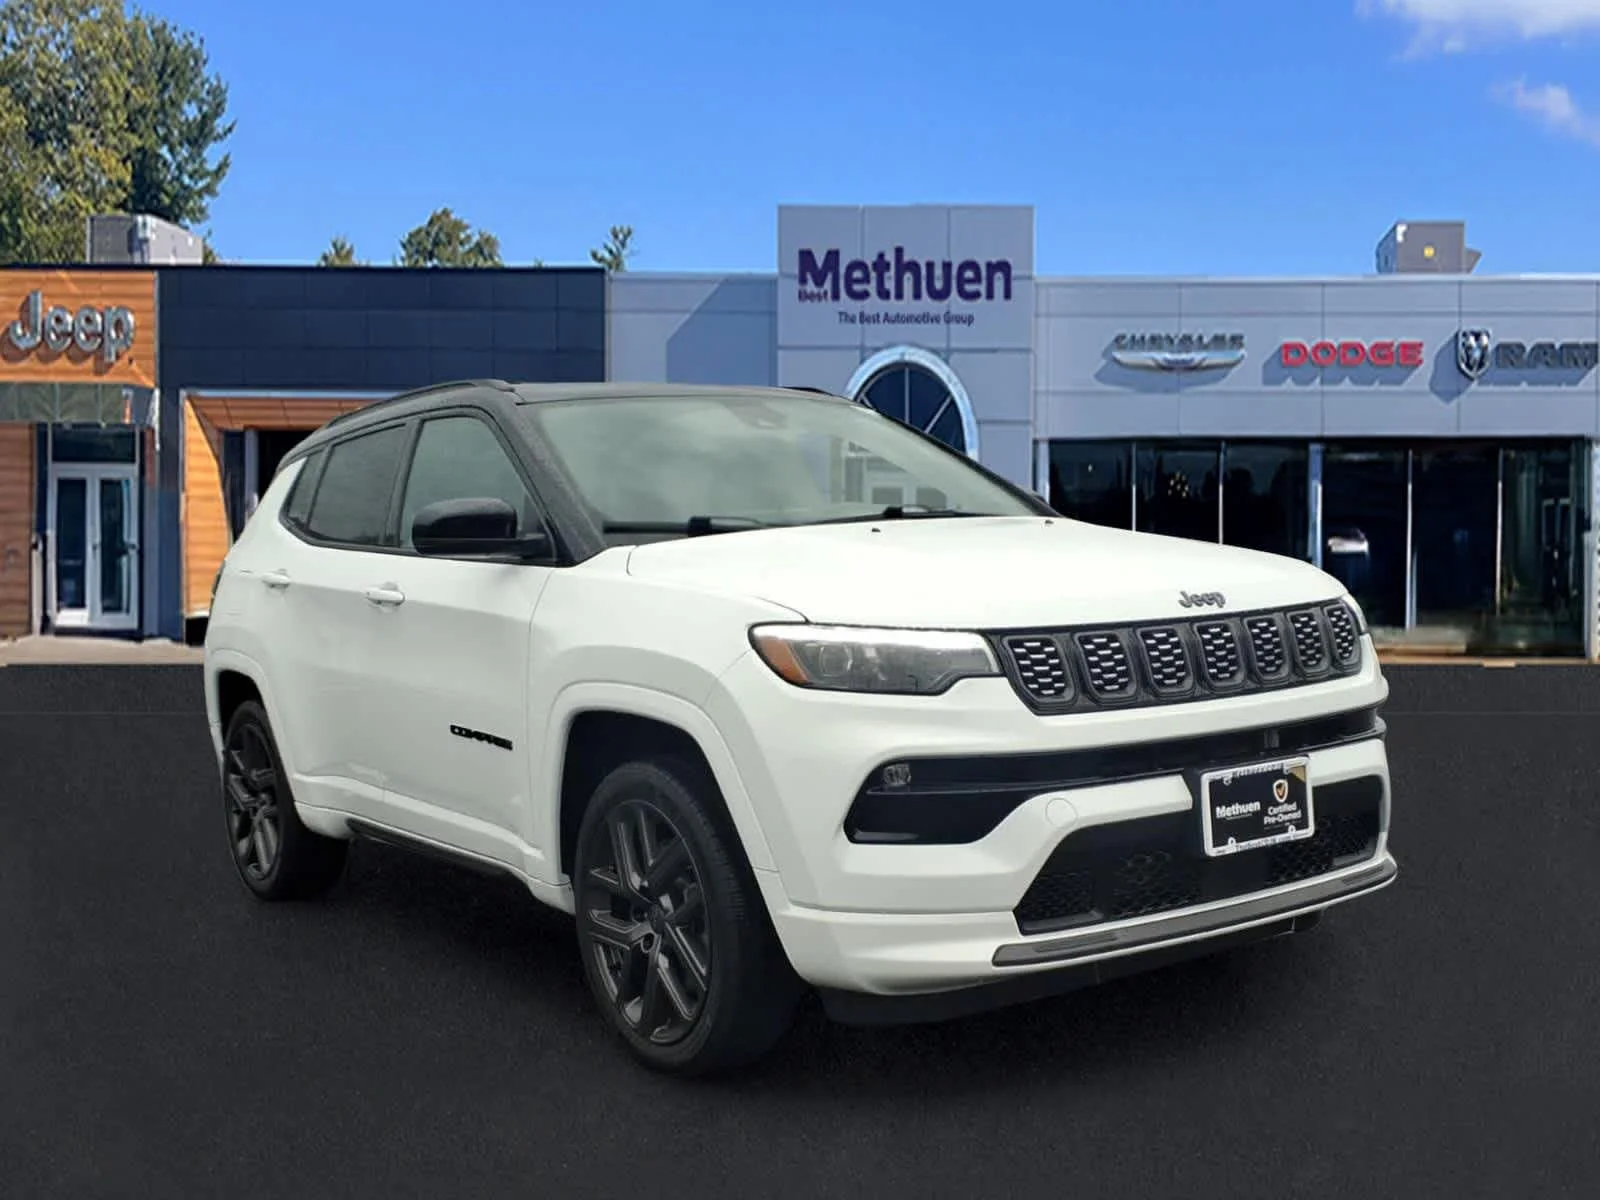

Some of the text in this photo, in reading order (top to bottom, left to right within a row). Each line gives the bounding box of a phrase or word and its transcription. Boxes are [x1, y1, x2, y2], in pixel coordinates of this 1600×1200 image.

[798, 246, 1012, 302] Methuen
[9, 289, 136, 363] Jeep
[838, 311, 975, 327] The Best Automotive Group
[1114, 332, 1245, 350] CHRYSLER
[1281, 340, 1424, 367] DODGE
[1495, 341, 1599, 369] RAM
[1178, 590, 1226, 609] Jeep
[1215, 801, 1261, 819] Methuen
[1267, 801, 1298, 816] Certified
[1263, 810, 1302, 826] Pre-Owned
